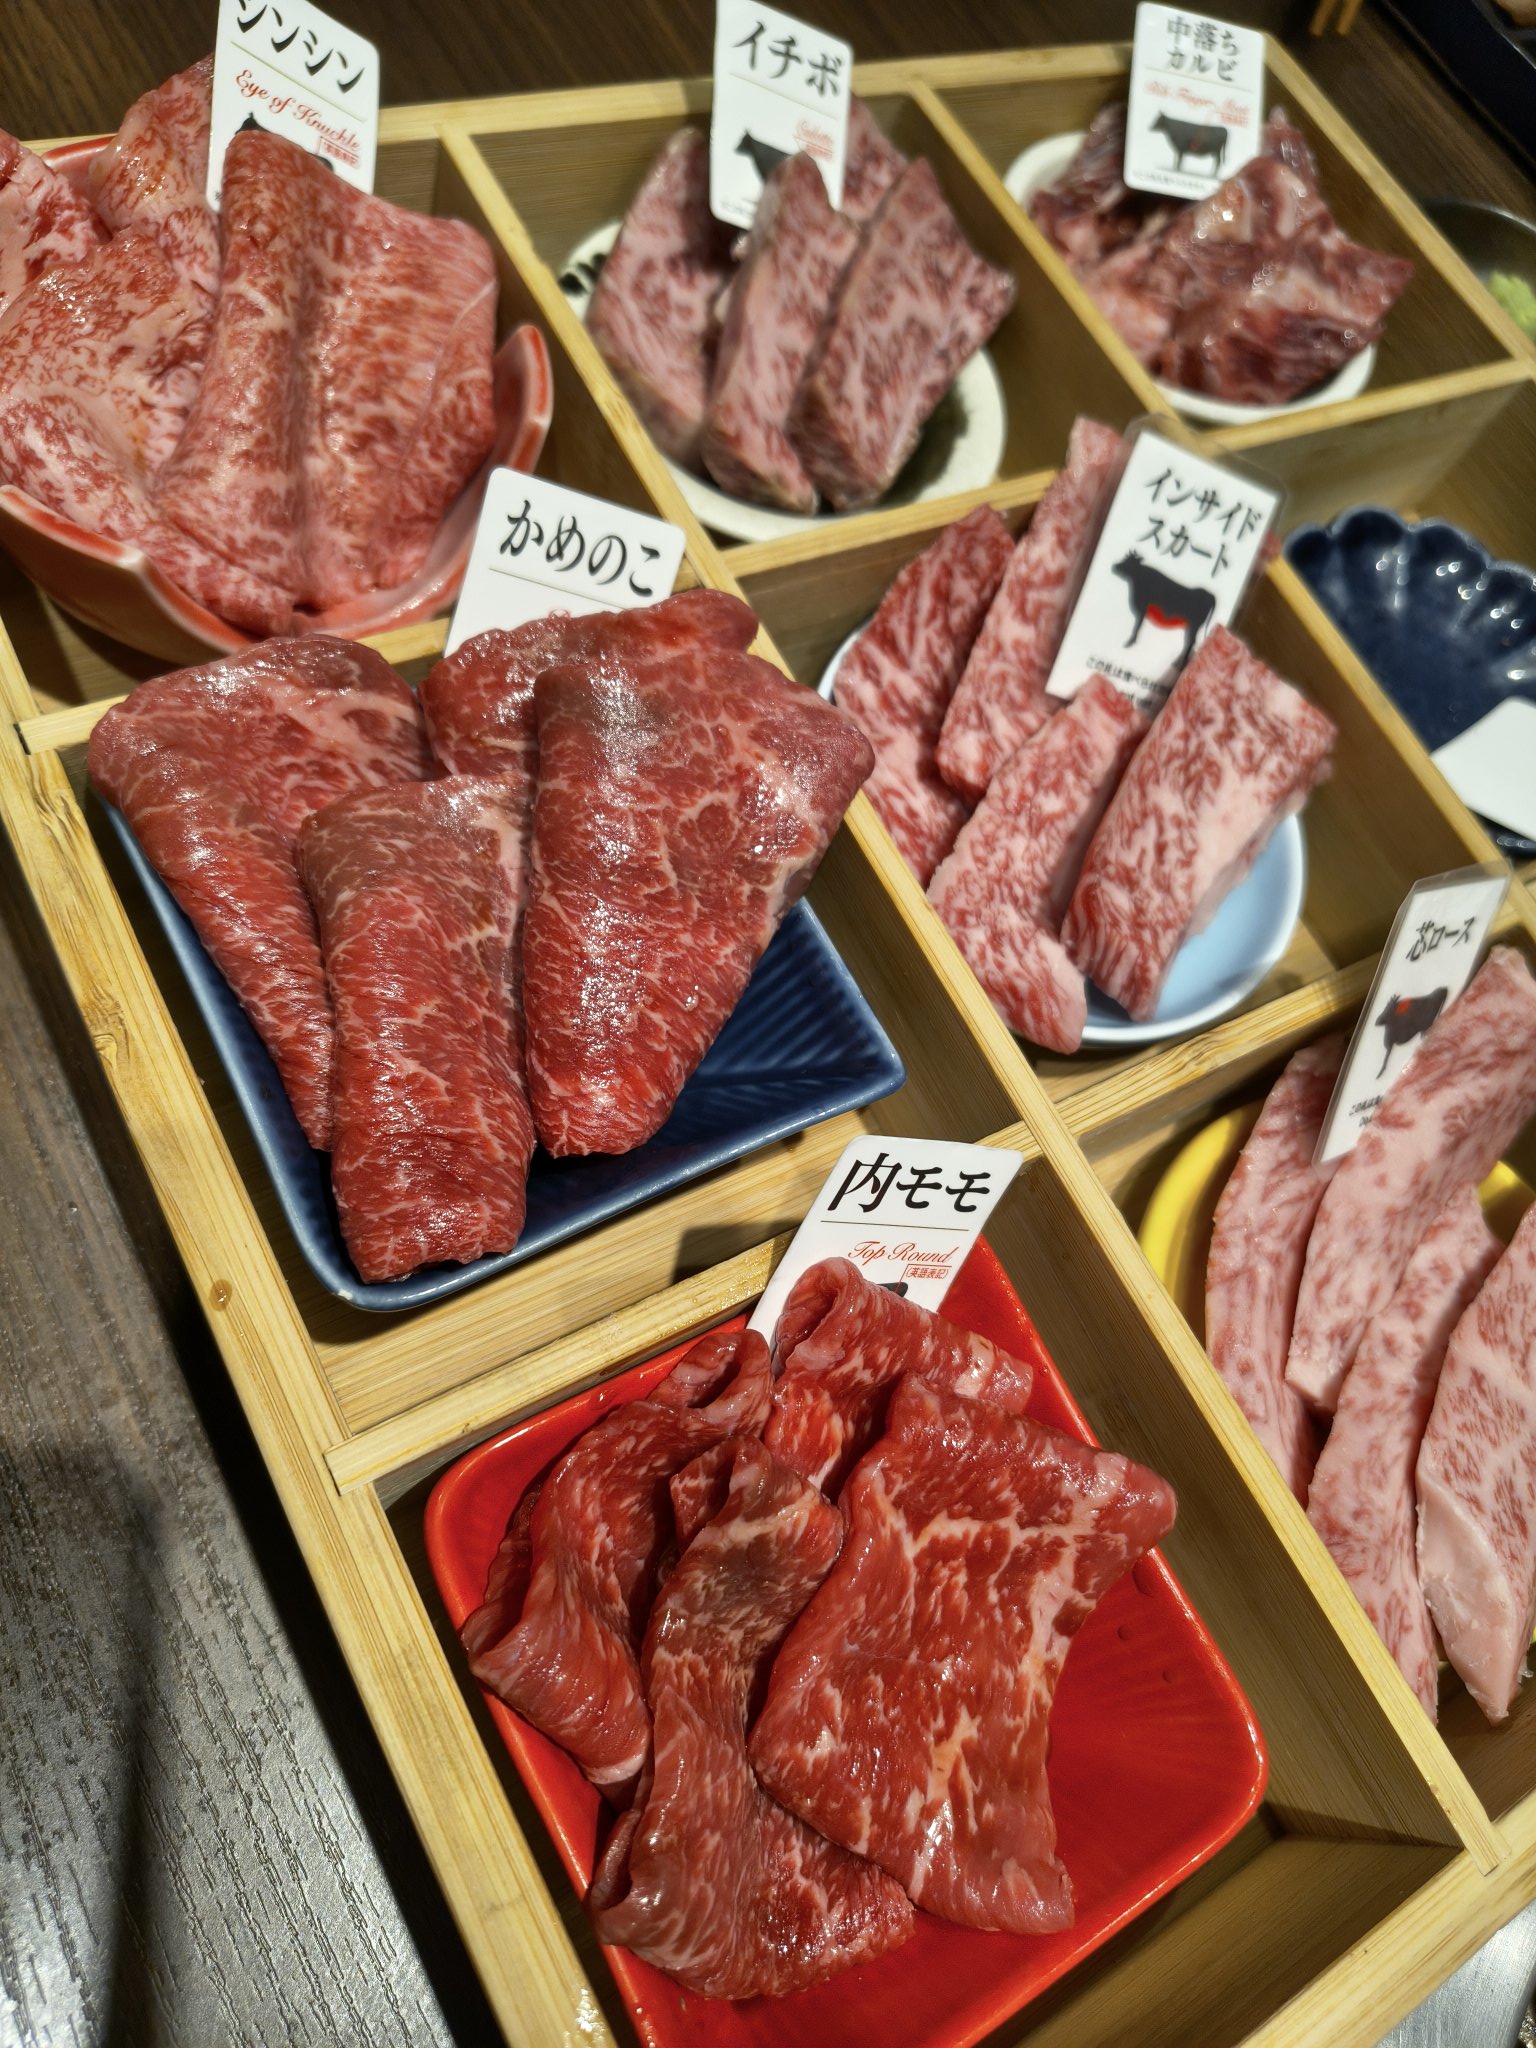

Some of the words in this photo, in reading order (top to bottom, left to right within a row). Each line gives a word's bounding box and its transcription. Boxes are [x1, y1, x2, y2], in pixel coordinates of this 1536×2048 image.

[730, 19, 845, 97] イチボ
[1167, 16, 1240, 56] 中落ち
[1167, 47, 1239, 82] カルビ
[235, 69, 270, 100] Eye
[269, 97, 296, 114] of
[292, 103, 361, 151] Knuckle
[1145, 467, 1262, 541] インサイド
[499, 499, 661, 597] かめのこ
[1137, 515, 1229, 577] スカート
[1405, 916, 1476, 962] 芯ロース
[827, 1152, 991, 1214] 内モモ
[847, 1240, 886, 1266] Top
[887, 1242, 960, 1264] Round
